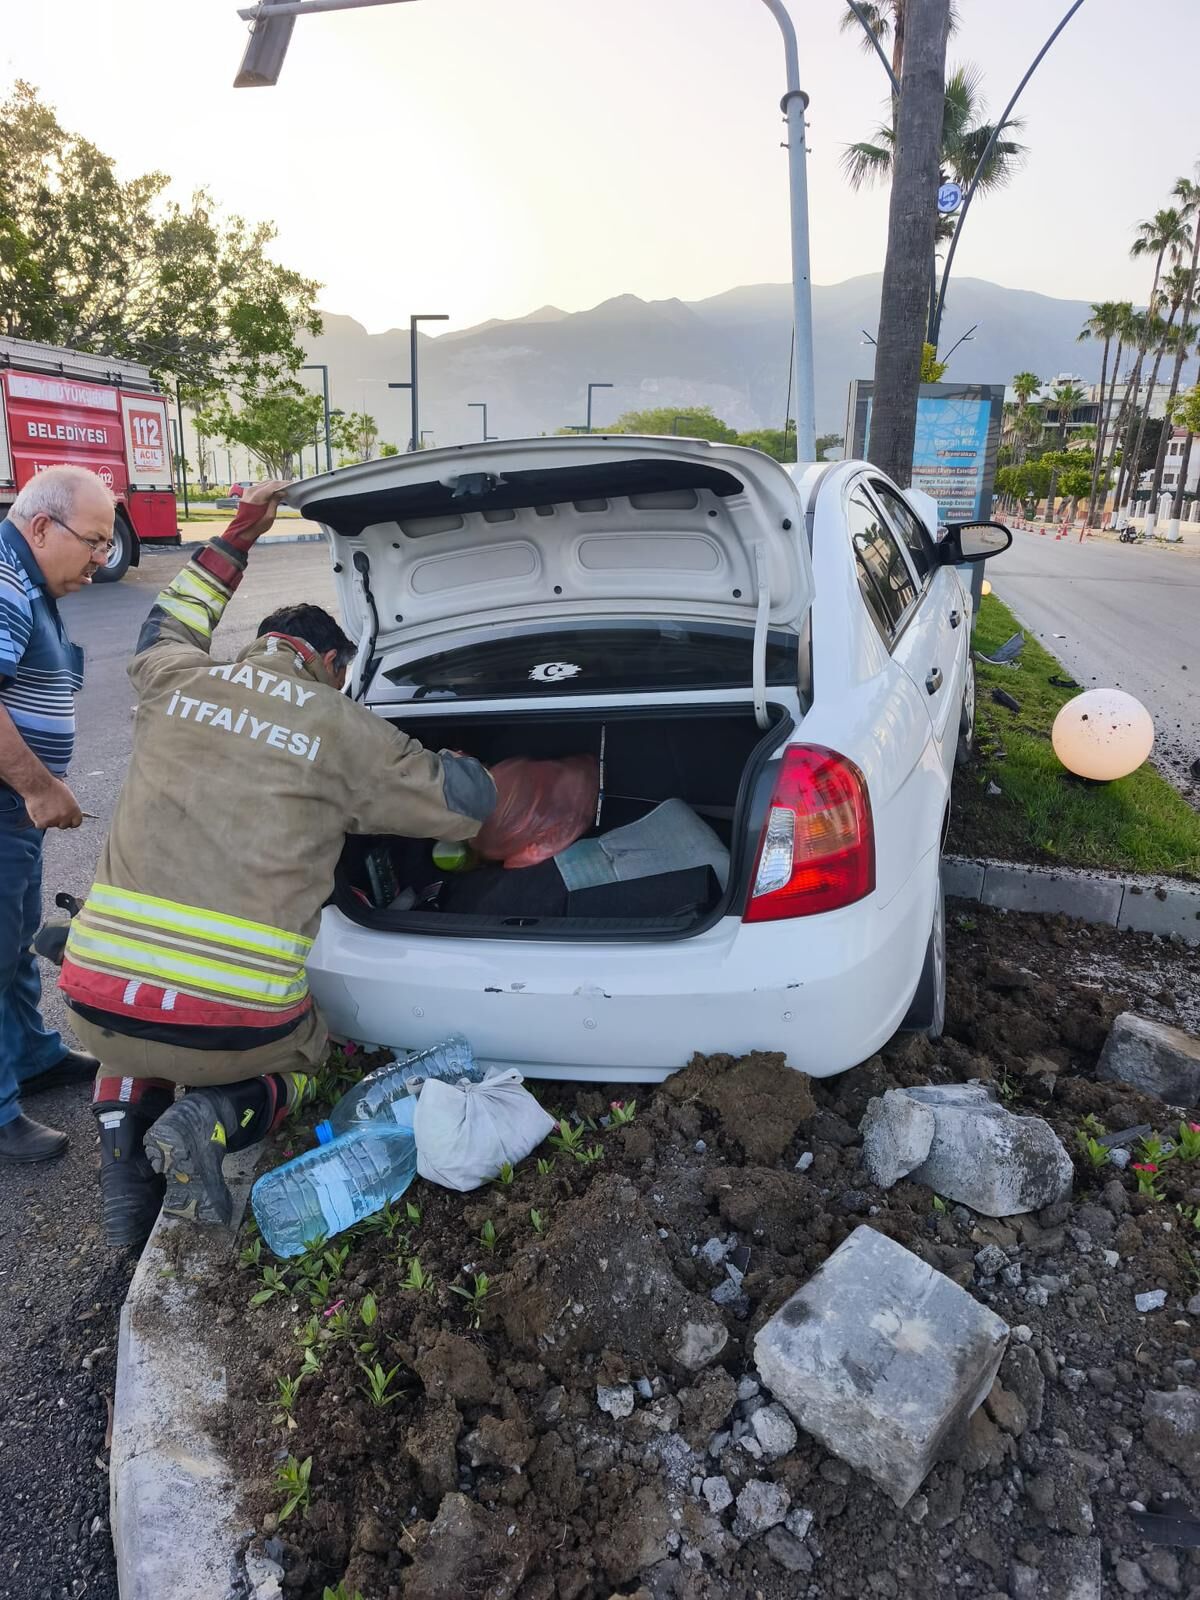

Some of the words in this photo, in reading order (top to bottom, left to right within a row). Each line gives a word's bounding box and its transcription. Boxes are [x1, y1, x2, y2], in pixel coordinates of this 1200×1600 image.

[27, 422, 107, 444] BELEDİYESİ
[133, 416, 160, 446] 112
[207, 662, 317, 708] HATAY
[166, 689, 322, 762] İTFAİYESİ
